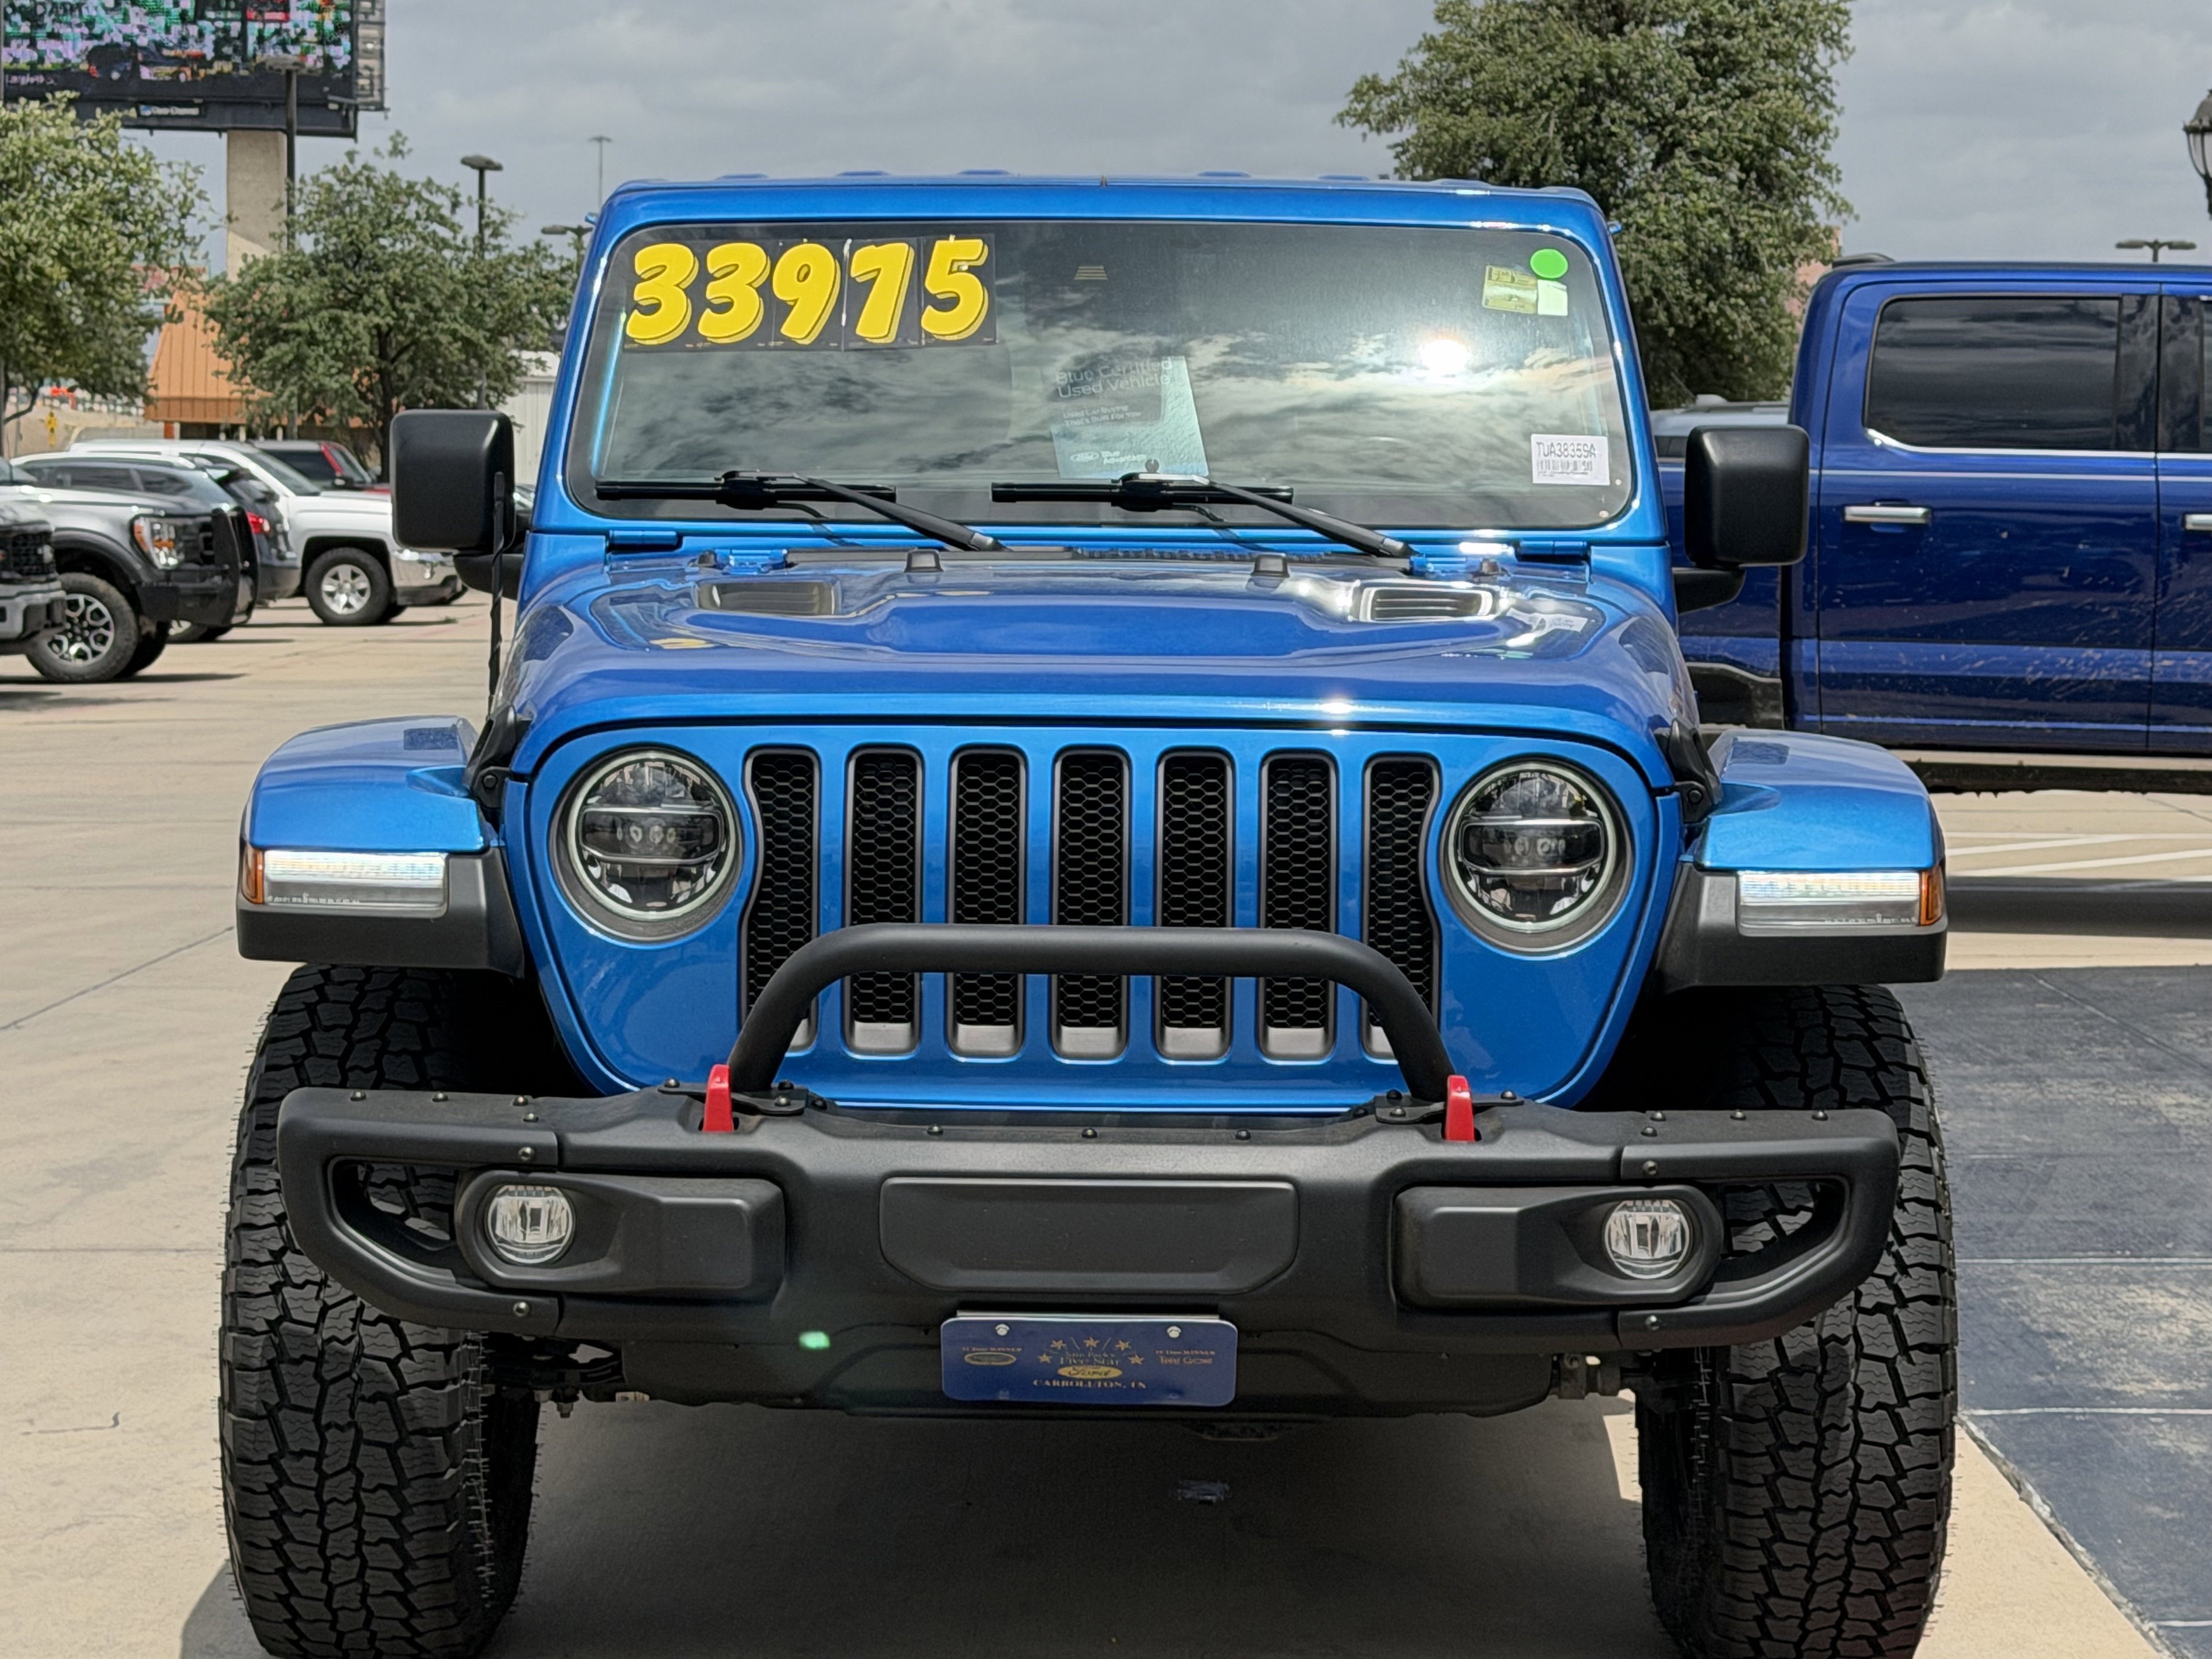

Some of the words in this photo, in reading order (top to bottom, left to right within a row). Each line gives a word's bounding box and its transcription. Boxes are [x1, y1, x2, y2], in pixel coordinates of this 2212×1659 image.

[626, 238, 989, 346] 33975
[1056, 369, 1094, 385] Blue
[1058, 382, 1104, 398] Used
[1107, 373, 1171, 392] Vehicle
[1536, 442, 1596, 459] TUA38359A
